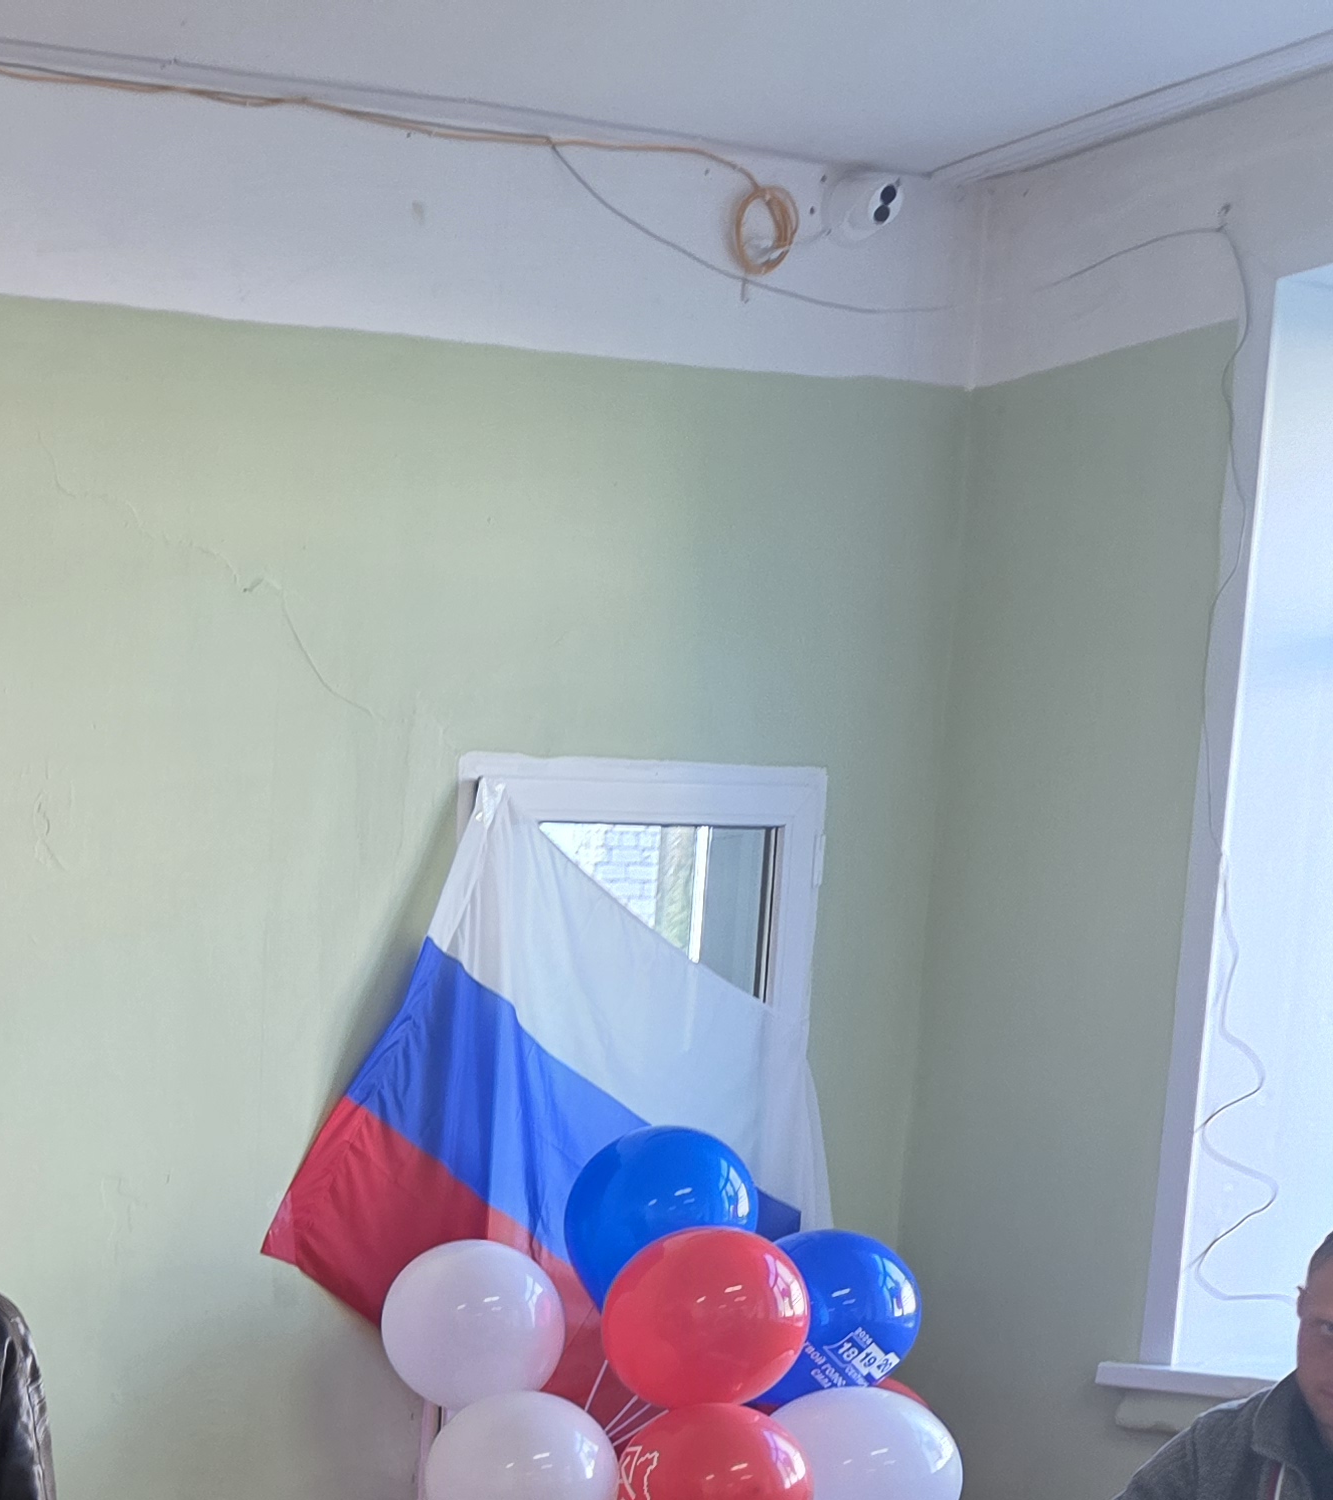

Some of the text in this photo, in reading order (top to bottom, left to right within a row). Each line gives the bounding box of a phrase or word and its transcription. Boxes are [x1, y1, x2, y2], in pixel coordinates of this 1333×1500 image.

[838, 1342, 893, 1373] 18 19 20
